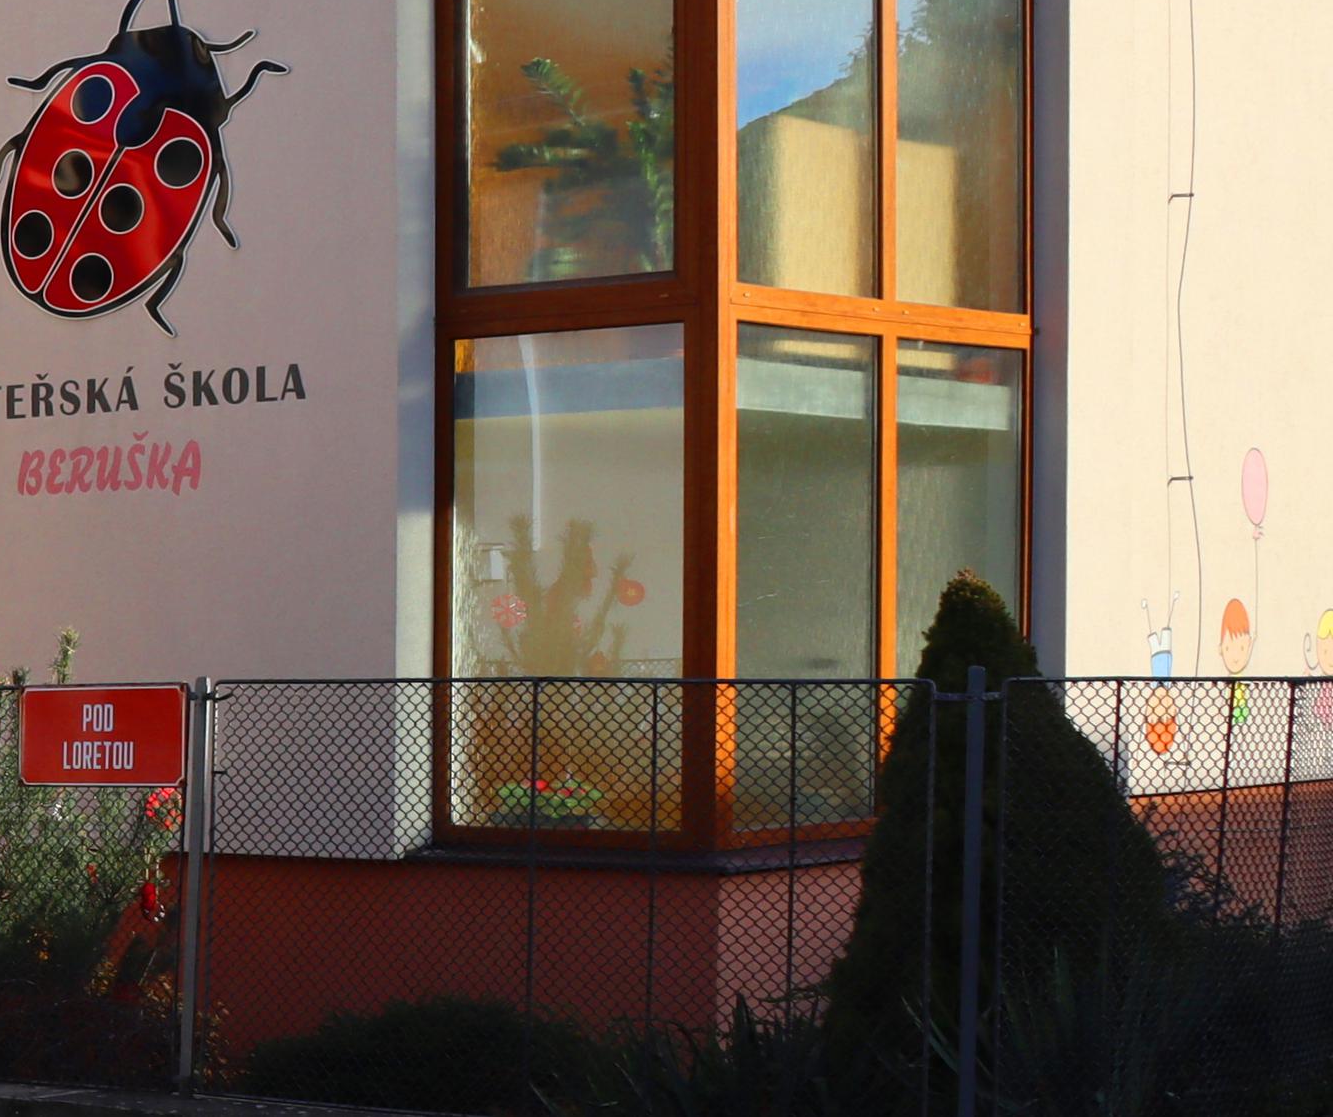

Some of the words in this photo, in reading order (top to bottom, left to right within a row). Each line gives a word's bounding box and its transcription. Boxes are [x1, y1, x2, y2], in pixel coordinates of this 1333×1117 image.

[163, 362, 307, 409] ŠKOLA
[16, 430, 202, 496] BERUŠKA
[82, 703, 114, 732] POD
[62, 741, 134, 770] LORETOU
